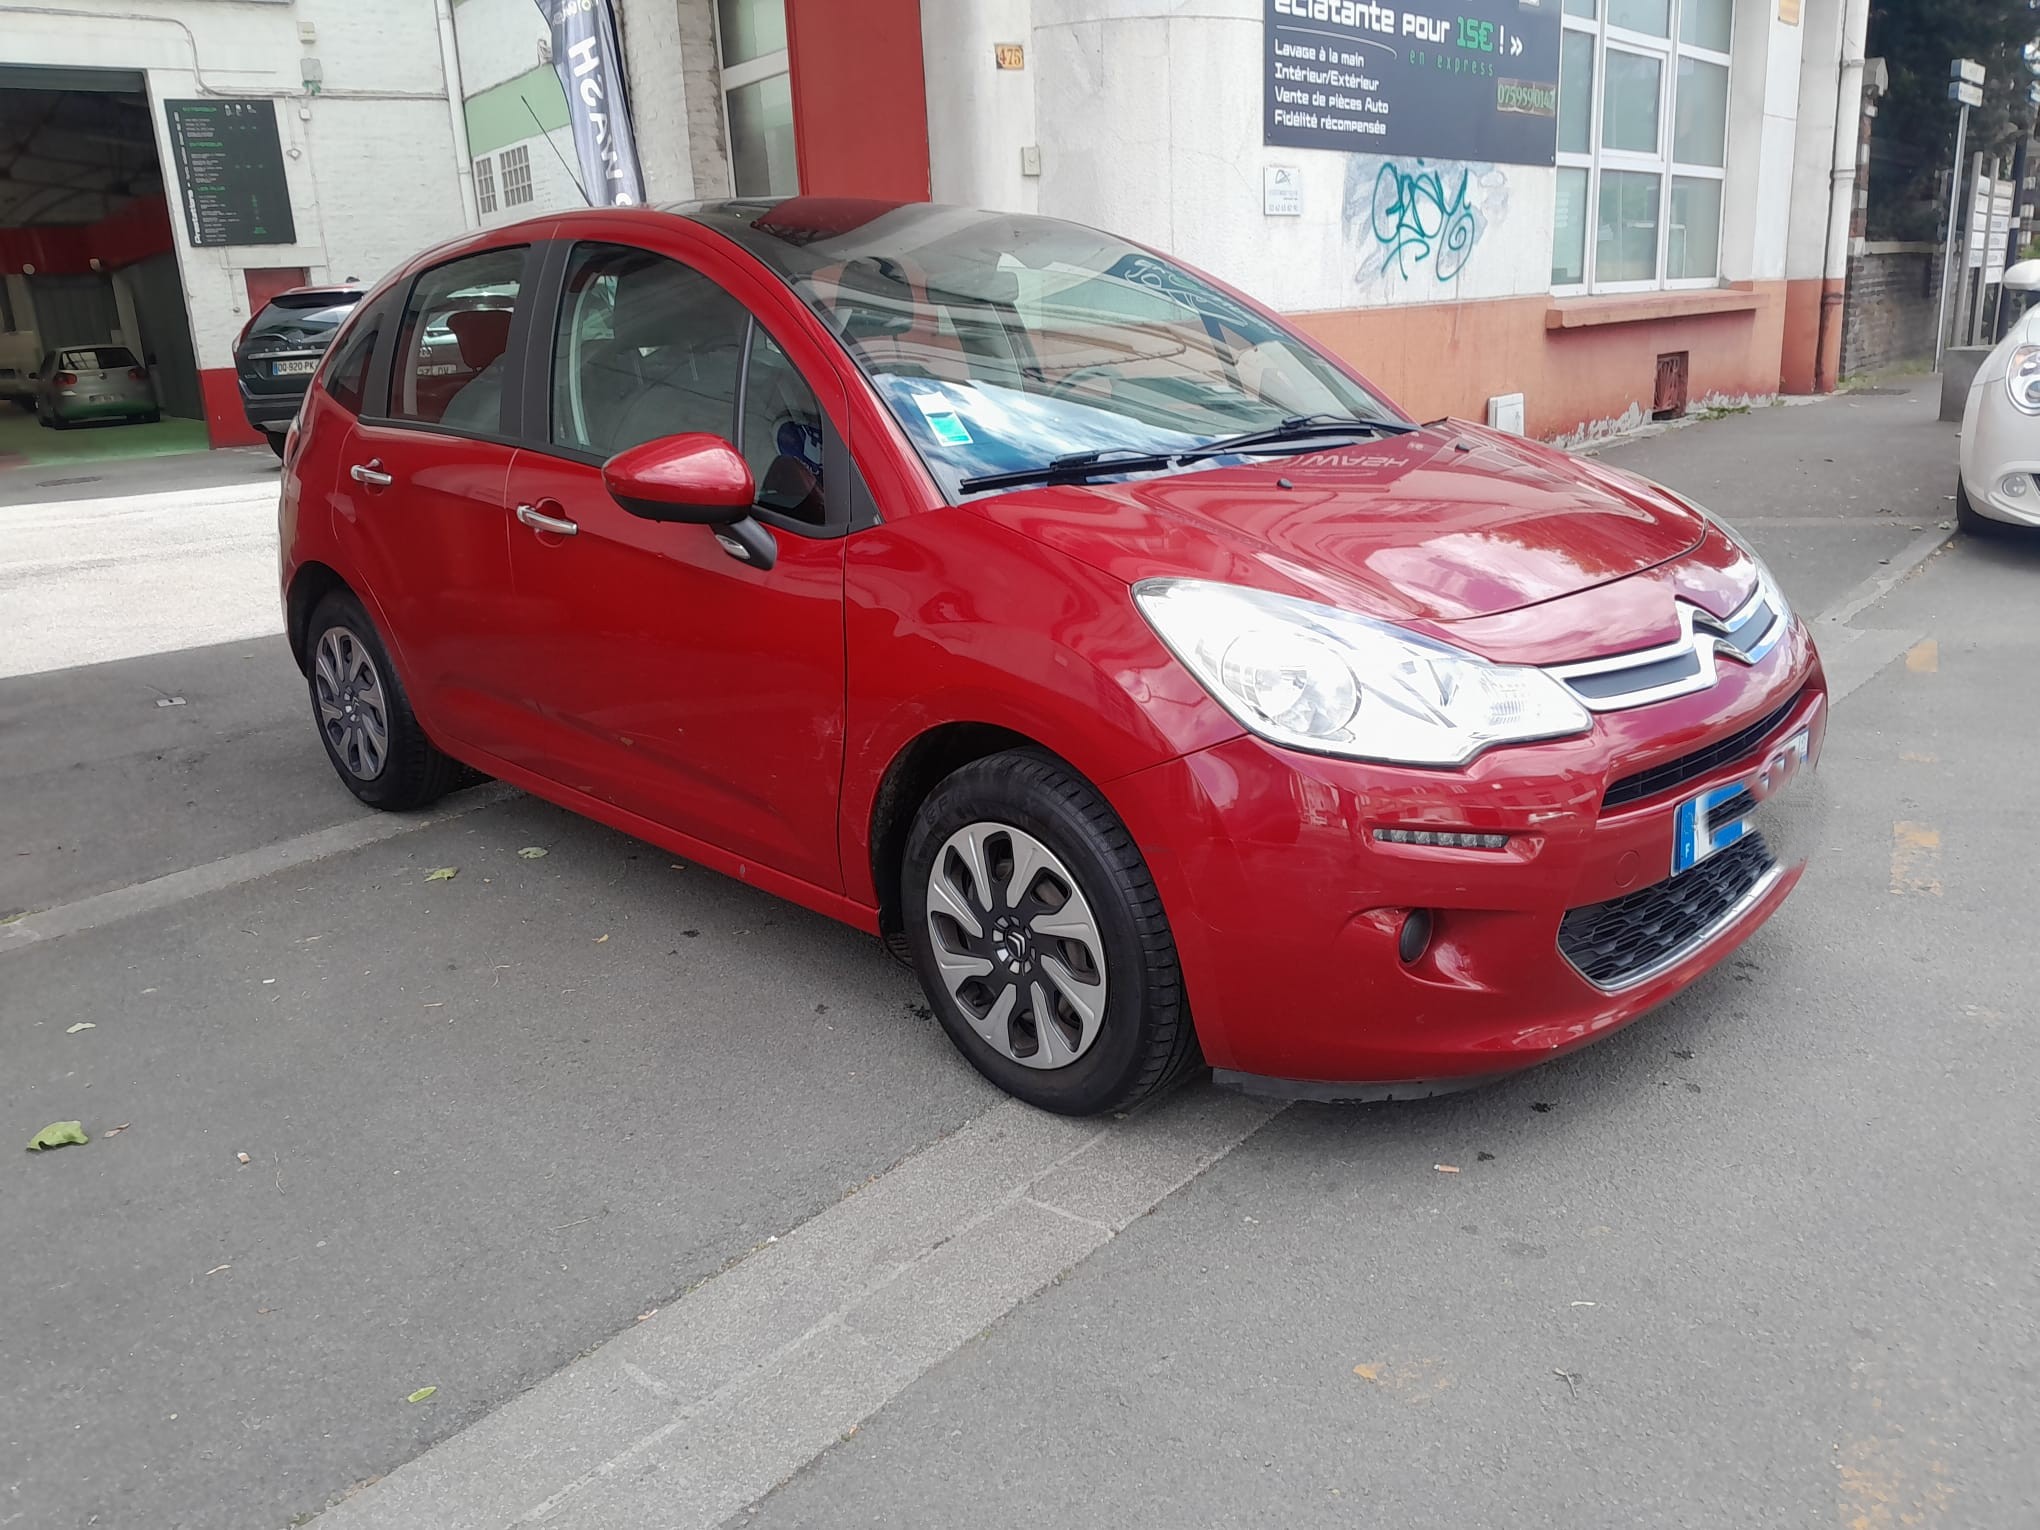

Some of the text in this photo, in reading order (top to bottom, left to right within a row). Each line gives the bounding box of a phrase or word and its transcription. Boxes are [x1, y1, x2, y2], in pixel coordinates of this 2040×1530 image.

[1402, 12, 1450, 43] pour
[1457, 16, 1494, 51] 15€
[1275, 38, 1364, 68] Lavage à la main
[1409, 49, 1494, 77] en express
[1275, 62, 1379, 91] Intérieur/Extérieur
[1275, 85, 1389, 114] Vente de pièces Auto
[1275, 109, 1386, 135] Fidélité récompensée
